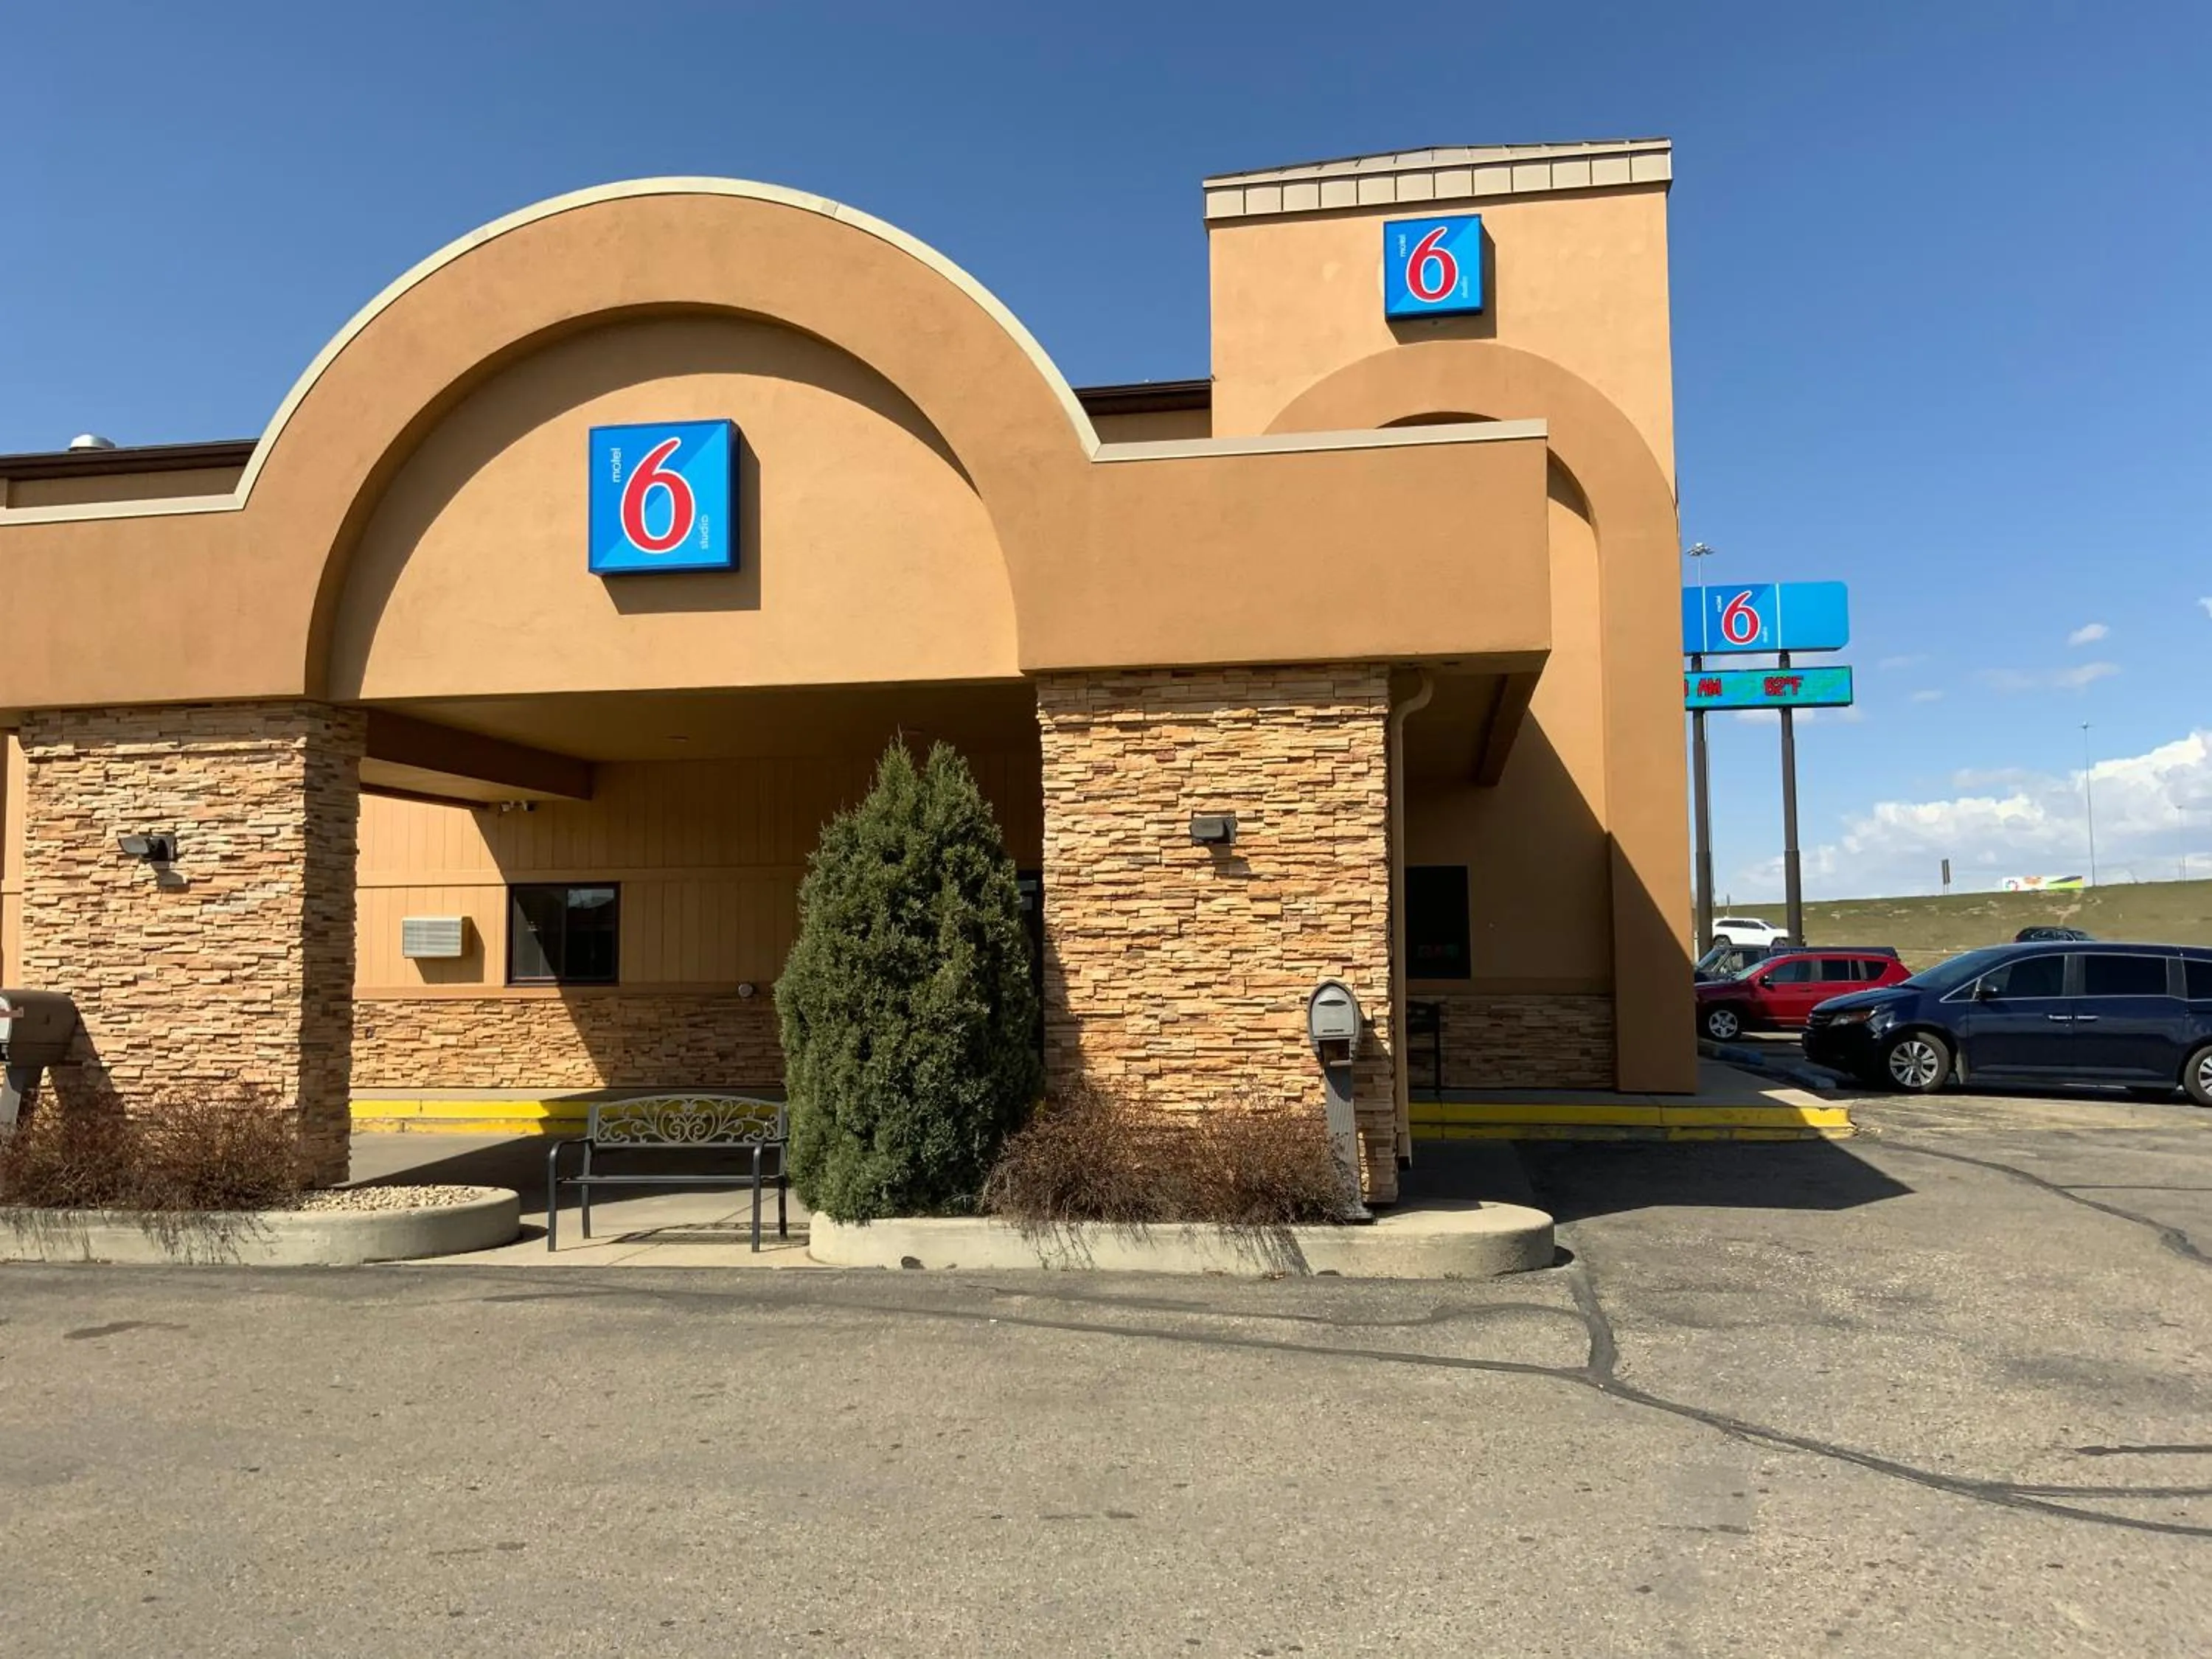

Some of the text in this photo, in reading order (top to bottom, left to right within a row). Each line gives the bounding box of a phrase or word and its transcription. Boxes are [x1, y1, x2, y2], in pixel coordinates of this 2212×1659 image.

[1406, 226, 1459, 302] 6
[611, 448, 622, 483] motel
[621, 437, 695, 554] 6
[699, 514, 709, 550] studio
[1722, 590, 1761, 645] 6
